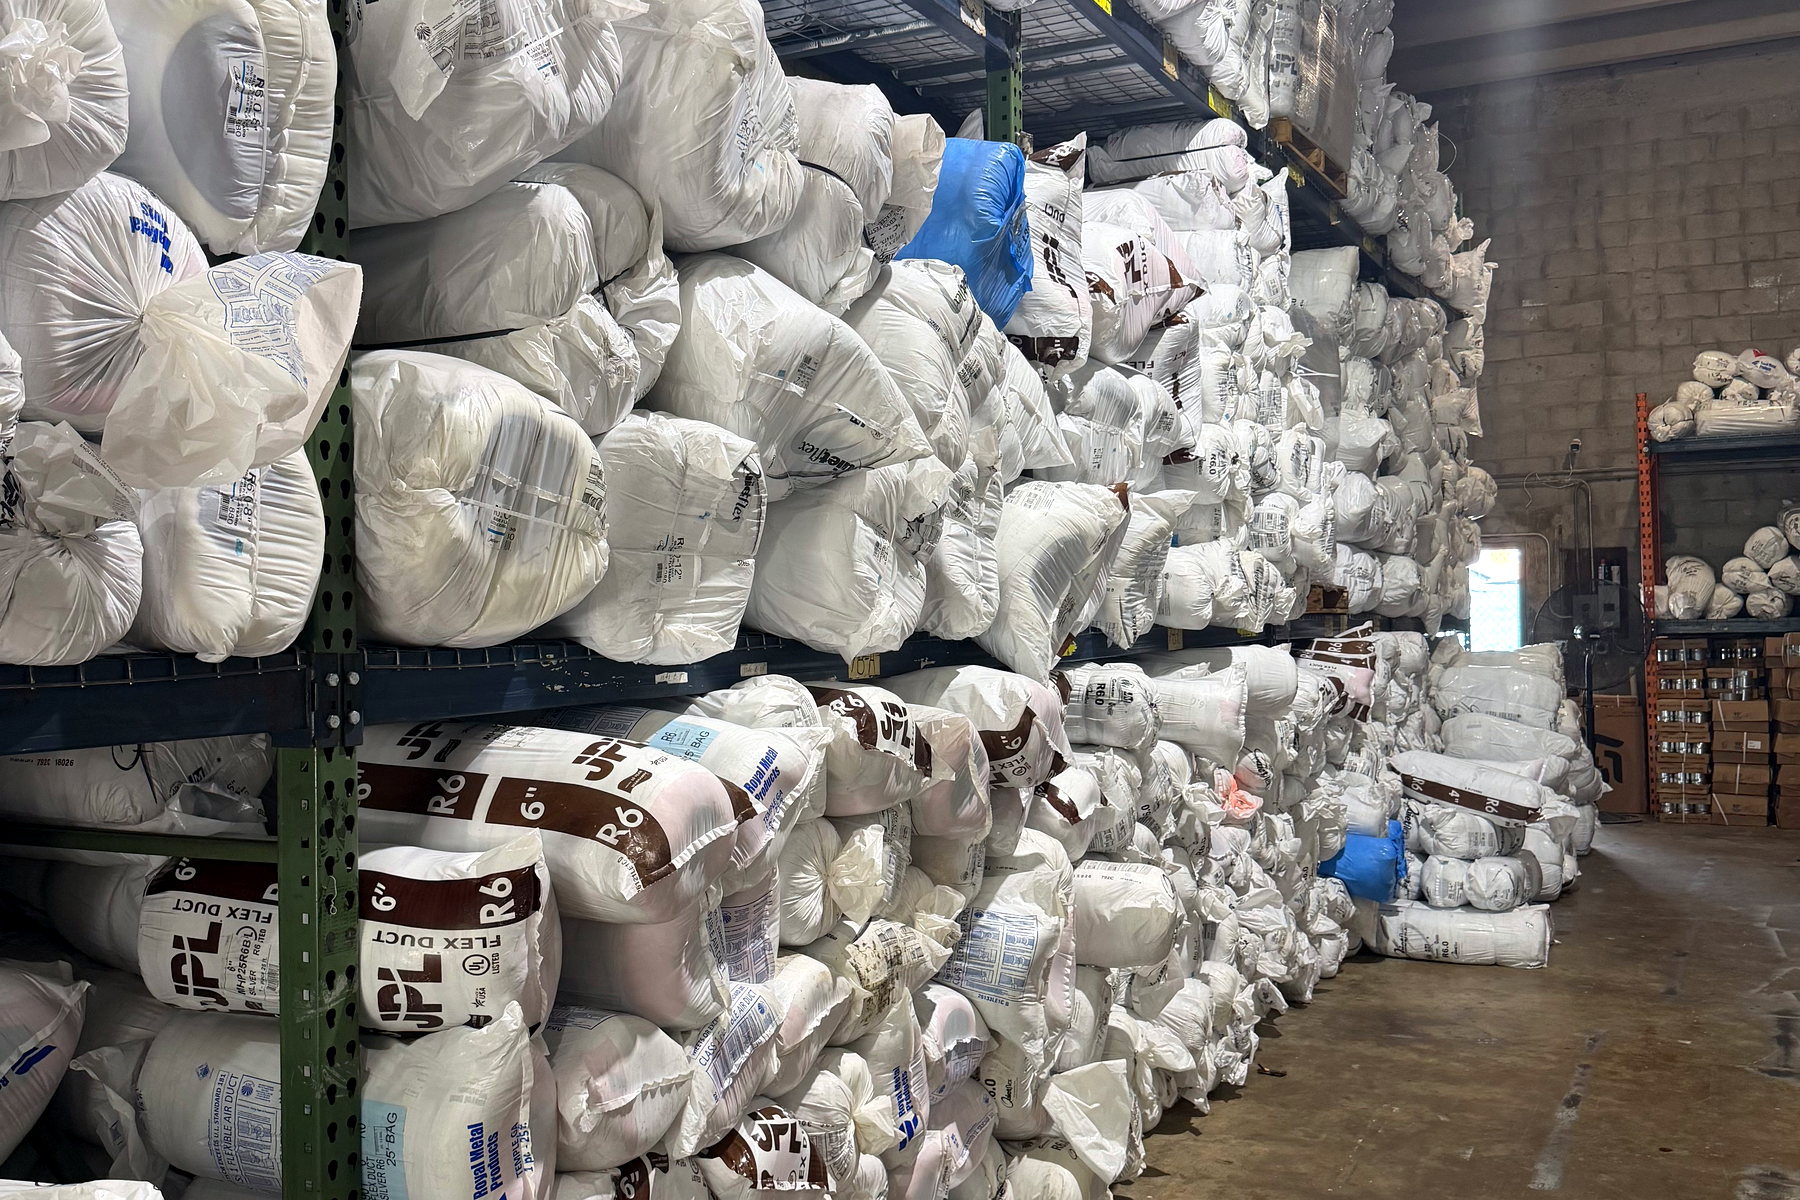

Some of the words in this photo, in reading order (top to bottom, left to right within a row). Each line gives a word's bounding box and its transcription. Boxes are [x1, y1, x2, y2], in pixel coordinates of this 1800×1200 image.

[55, 759, 74, 767] 18026
[743, 764, 767, 795] Royal
[759, 745, 778, 773] Metal
[427, 774, 466, 815] R6
[755, 766, 781, 802] Products
[521, 786, 545, 821] 6"
[1485, 797, 1499, 814] R6
[596, 806, 644, 846] R6
[175, 857, 197, 881] 6"
[172, 898, 221, 917] DUCT
[372, 882, 396, 912] 6"
[479, 877, 516, 925] R6
[226, 906, 272, 924] FLEX
[252, 944, 260, 956] R6
[372, 930, 434, 949] DUCT
[443, 934, 502, 950] FLEX
[1442, 941, 1450, 958] R6.0
[171, 921, 230, 1007] JPL
[491, 952, 500, 975] LISTED
[249, 969, 257, 996] SILVER
[377, 953, 444, 1029] JPL
[699, 1042, 717, 1067] CLASS
[217, 1073, 227, 1087] 181
[224, 1073, 239, 1104] DUCT
[901, 1070, 914, 1112] Products
[213, 1088, 222, 1124] STANDARD
[223, 1107, 232, 1123] AIR
[894, 1092, 906, 1118] Royal
[386, 1111, 398, 1143] BAG
[224, 1125, 235, 1165] FLEXIBLE
[467, 1122, 485, 1161] Metal
[365, 1155, 376, 1181] DUCT
[377, 1159, 385, 1171] R6
[386, 1147, 397, 1167] 25'
[487, 1131, 504, 1193] Products
[472, 1161, 489, 1200] Royal
[620, 1170, 640, 1199] 6"
